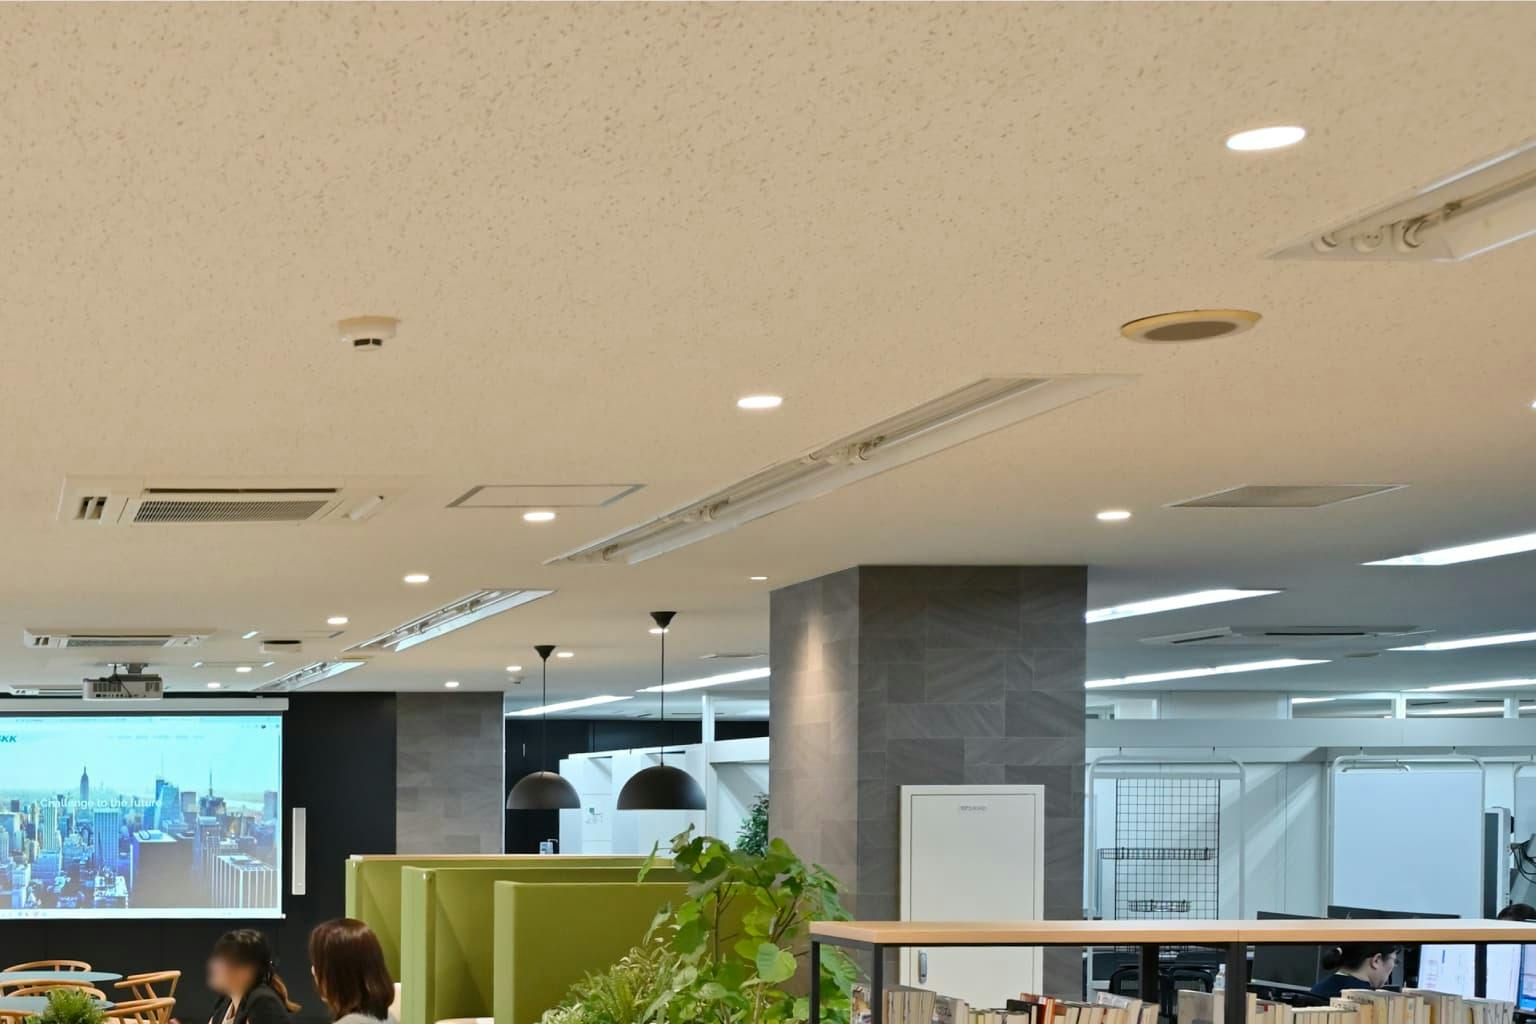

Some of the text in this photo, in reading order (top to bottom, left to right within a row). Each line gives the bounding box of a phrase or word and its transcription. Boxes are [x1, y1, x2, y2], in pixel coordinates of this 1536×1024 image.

[39, 798, 163, 810] Challenge to the future
